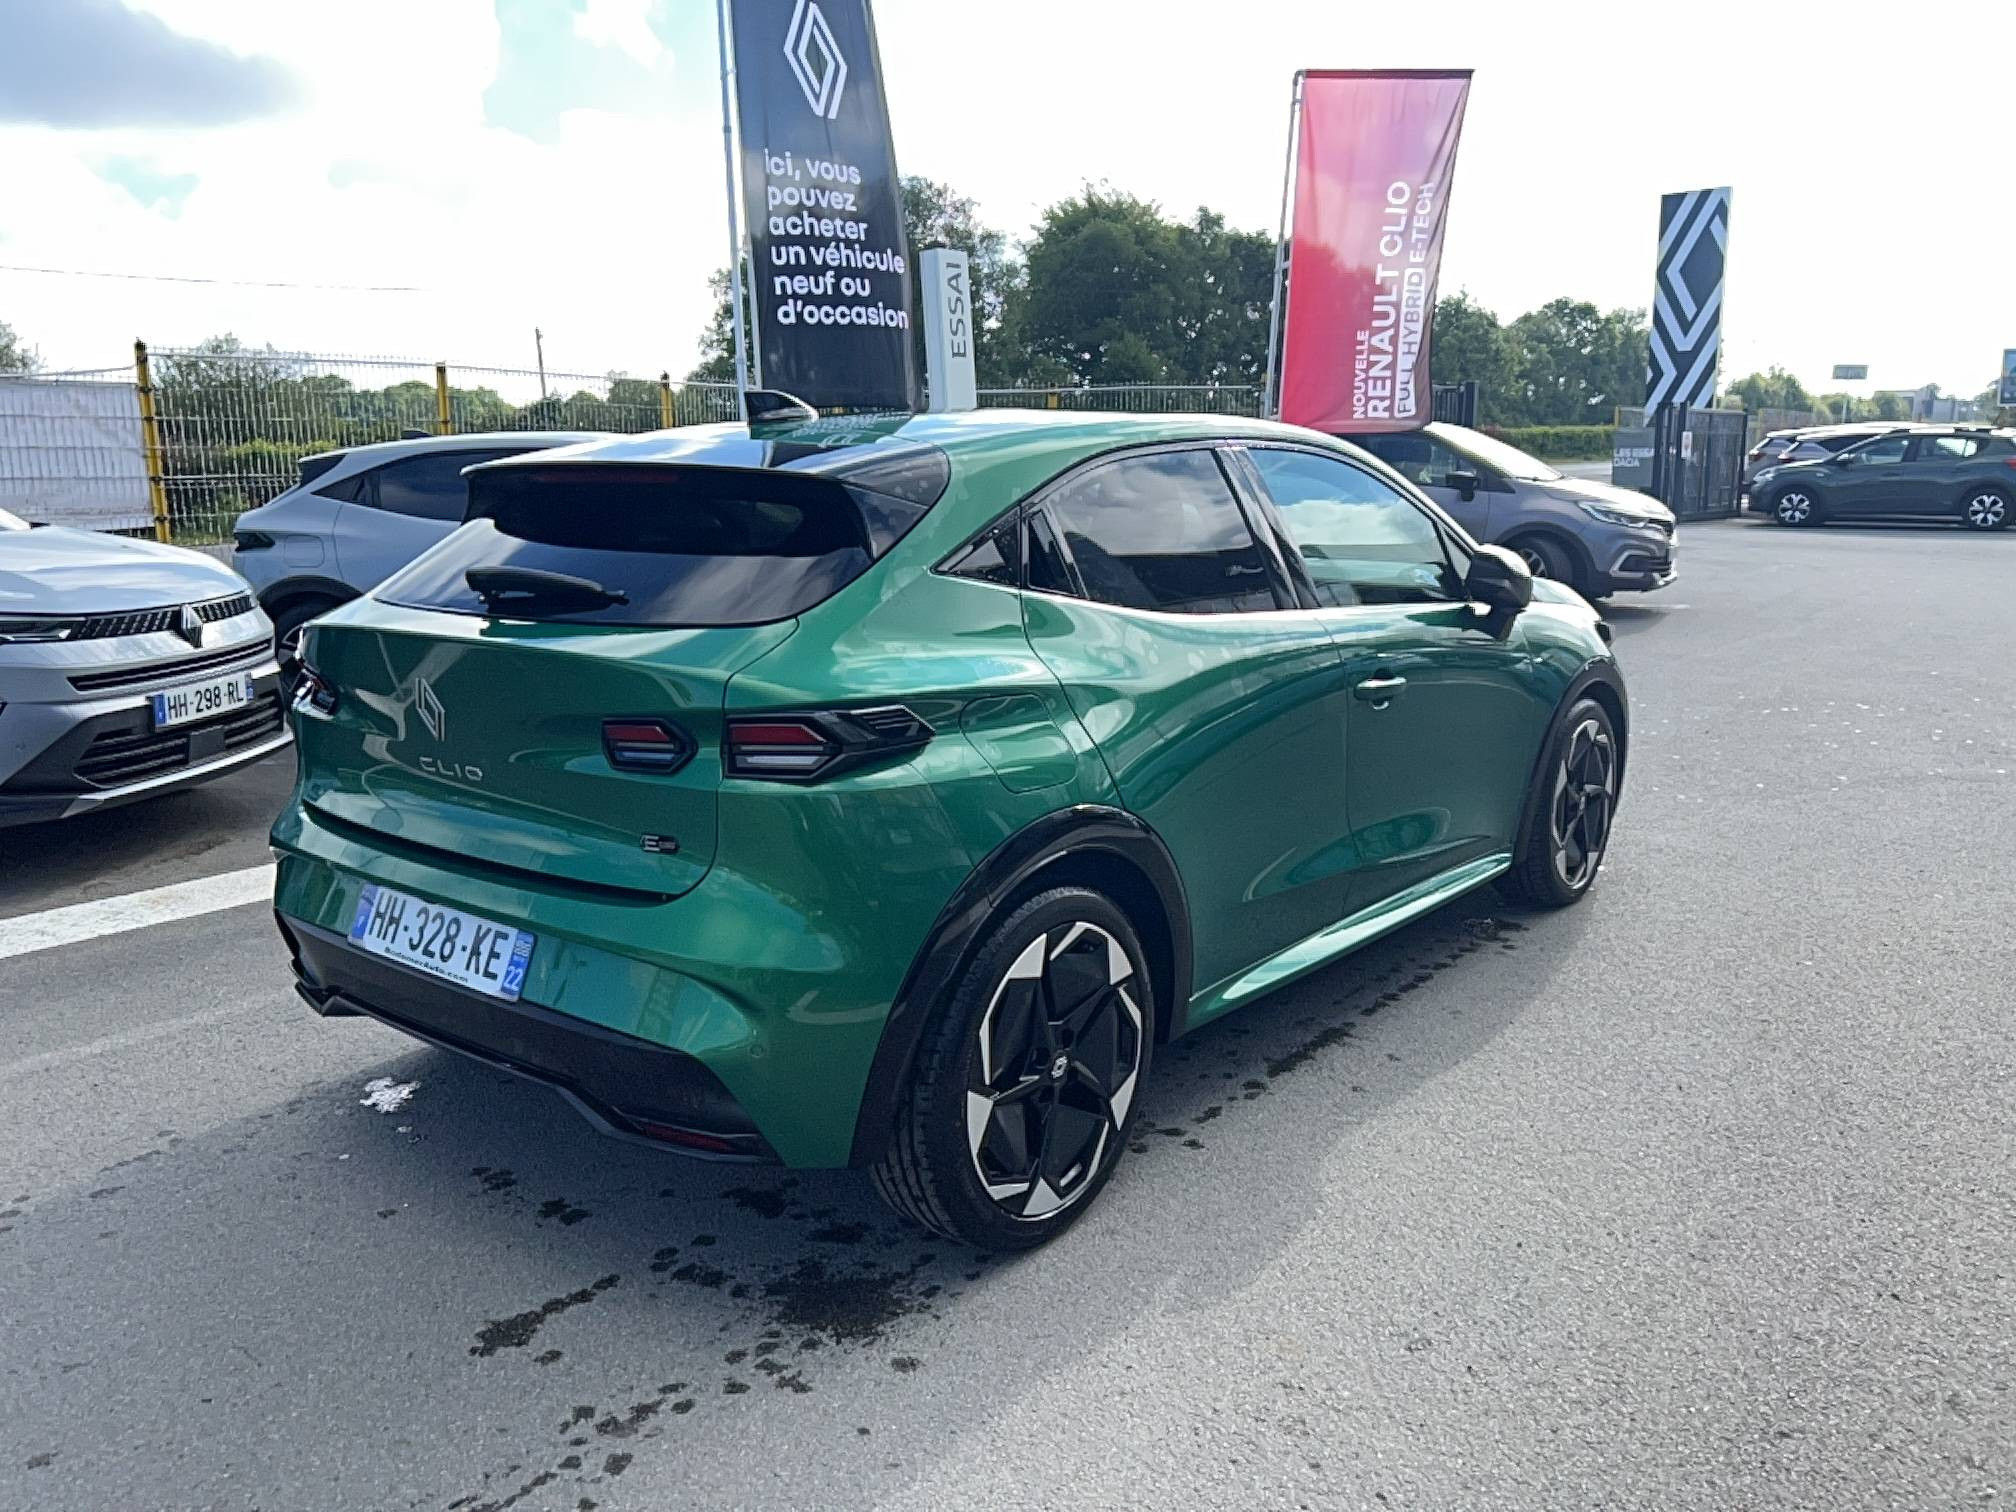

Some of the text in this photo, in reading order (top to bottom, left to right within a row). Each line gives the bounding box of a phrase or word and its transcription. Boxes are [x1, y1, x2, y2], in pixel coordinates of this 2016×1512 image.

[806, 157, 861, 185] vous
[767, 184, 857, 211] pouvez
[769, 211, 868, 241] acheter
[1409, 182, 1435, 263] E-TECH
[771, 241, 905, 274] un véhicule
[774, 271, 871, 297] neuf ou
[1367, 181, 1411, 418] RENAULT CLIO
[777, 298, 909, 329] d'occasion
[946, 262, 968, 359] ESSAI
[1402, 270, 1424, 355] HYBRID
[1353, 330, 1369, 419] NOUVELLE
[167, 681, 244, 720] HH-298-RL
[418, 756, 483, 781] CLIO
[368, 892, 524, 992] HH-328-KE 22
